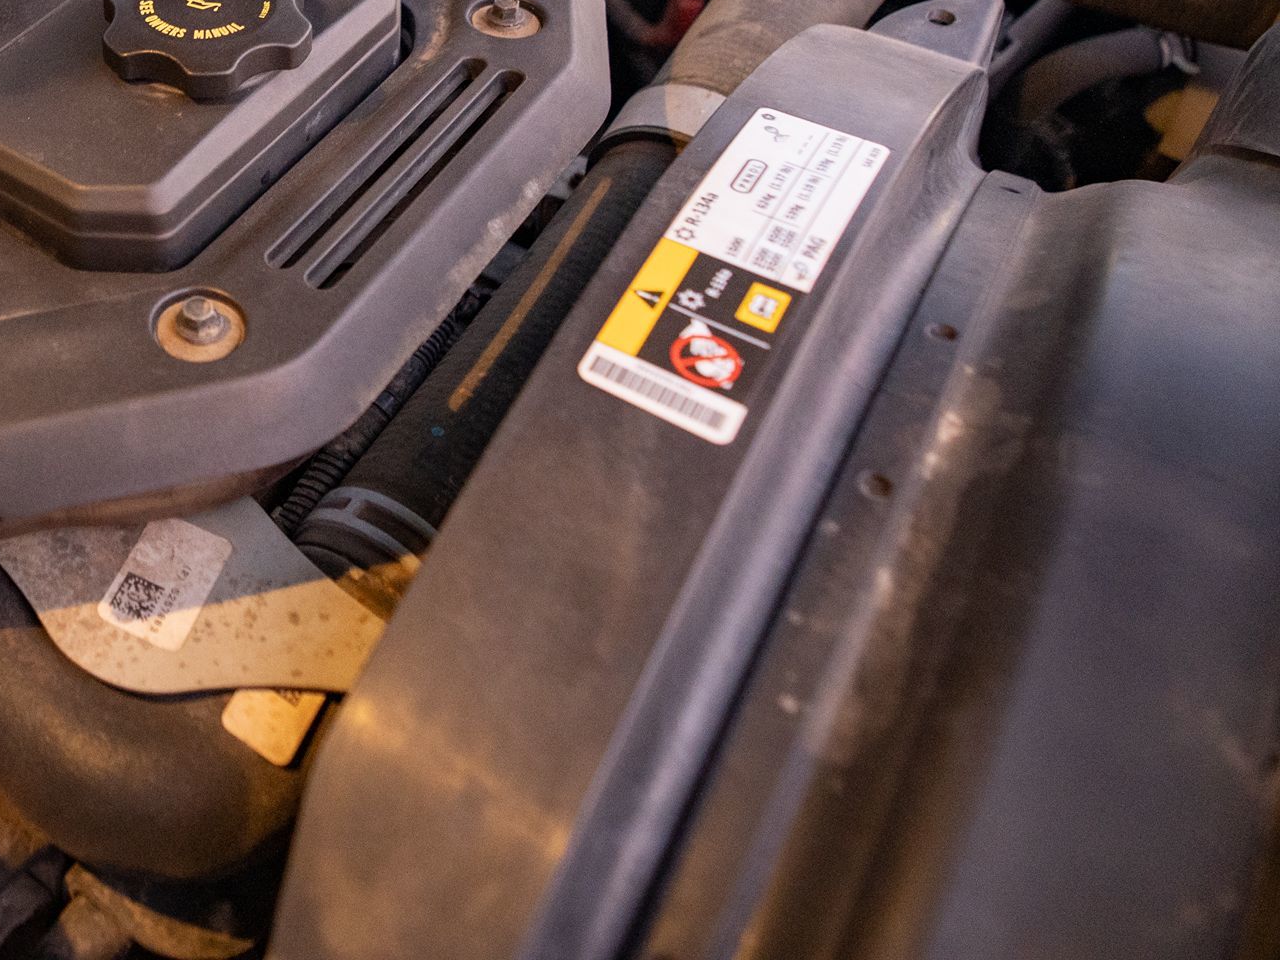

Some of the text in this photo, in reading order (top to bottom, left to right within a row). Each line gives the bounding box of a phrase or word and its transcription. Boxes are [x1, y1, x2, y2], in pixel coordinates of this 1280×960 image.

[138, 0, 245, 40] SEE OWNERS MANUAL
[687, 192, 720, 227] R-134a
